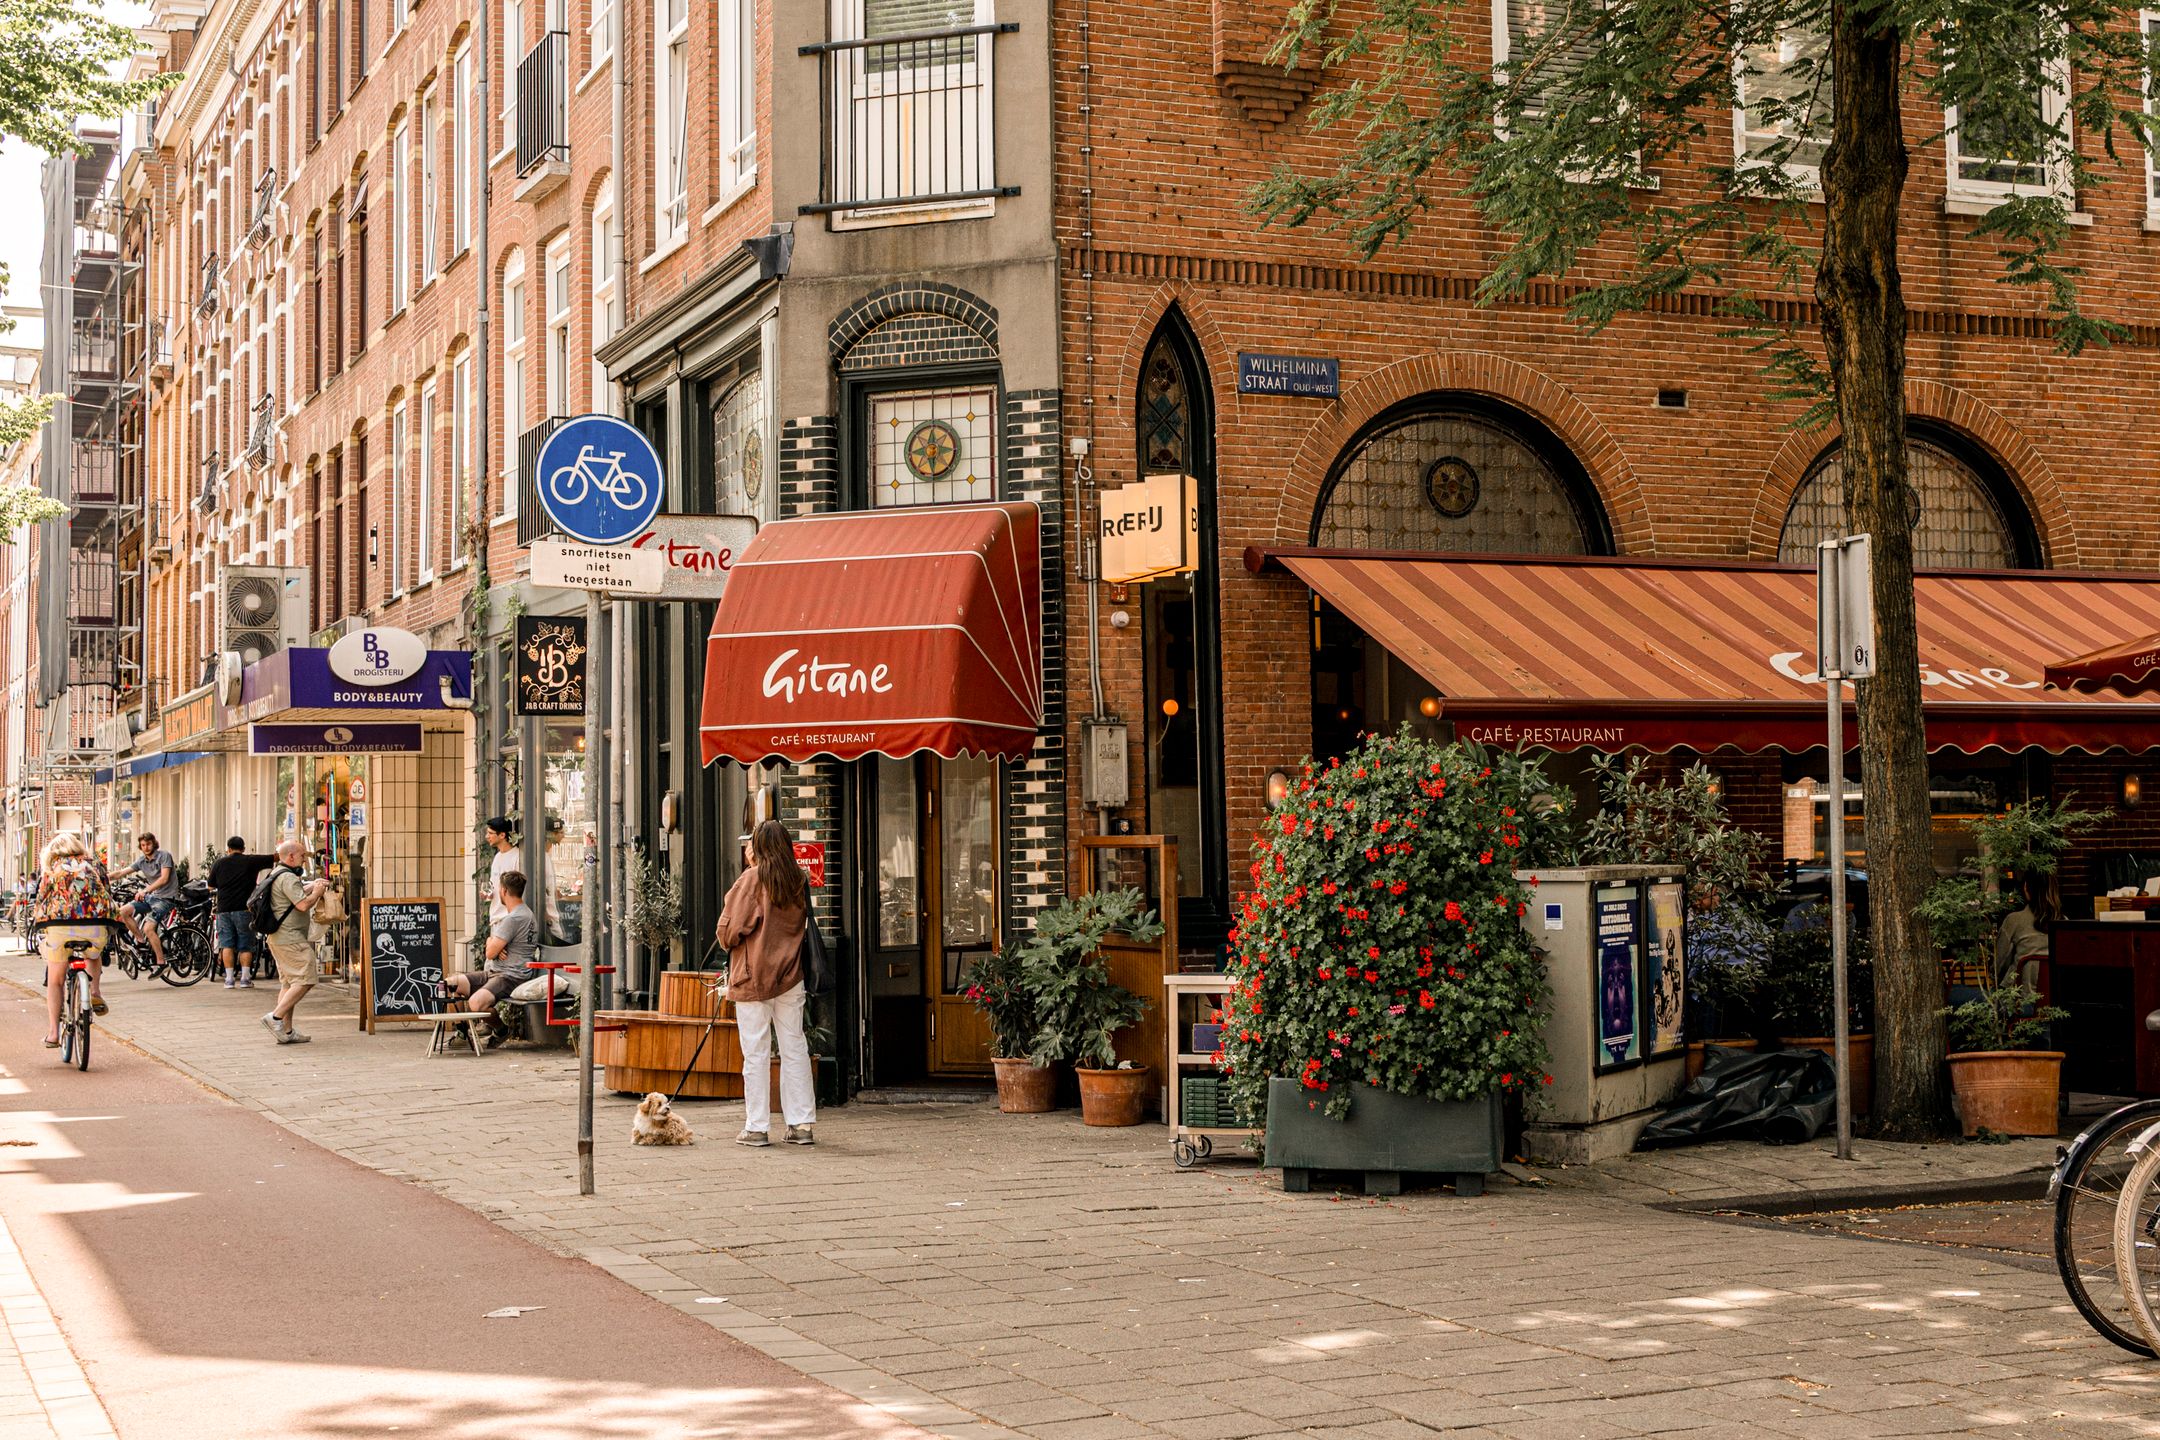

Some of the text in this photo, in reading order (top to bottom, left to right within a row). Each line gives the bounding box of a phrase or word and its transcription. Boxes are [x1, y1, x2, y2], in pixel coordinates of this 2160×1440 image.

[1250, 358, 1328, 376] WILHELMINA
[1245, 374, 1334, 394] STRAAT OUD-WEST
[561, 548, 631, 561] snorfietsen
[632, 532, 734, 573] tane
[586, 563, 610, 572] niet
[564, 574, 632, 587] toegestaan
[353, 668, 404, 677] DROGISTERIJ
[762, 648, 893, 704] Gitane
[1769, 651, 2041, 690] Gane
[333, 692, 423, 702] BODY&BEAUTY
[525, 702, 583, 710] J&B CRAFT DRINKS
[806, 732, 876, 745] RESTAURANT
[1523, 727, 1625, 743] RESTAURANT
[269, 743, 406, 753] DROGISTERIJ BODY&BEAUTY
[402, 905, 406, 914] I
[408, 905, 427, 914] WAS
[372, 914, 438, 923] LISTENING WITH
[372, 922, 389, 931] HALF
[391, 922, 397, 930] A
